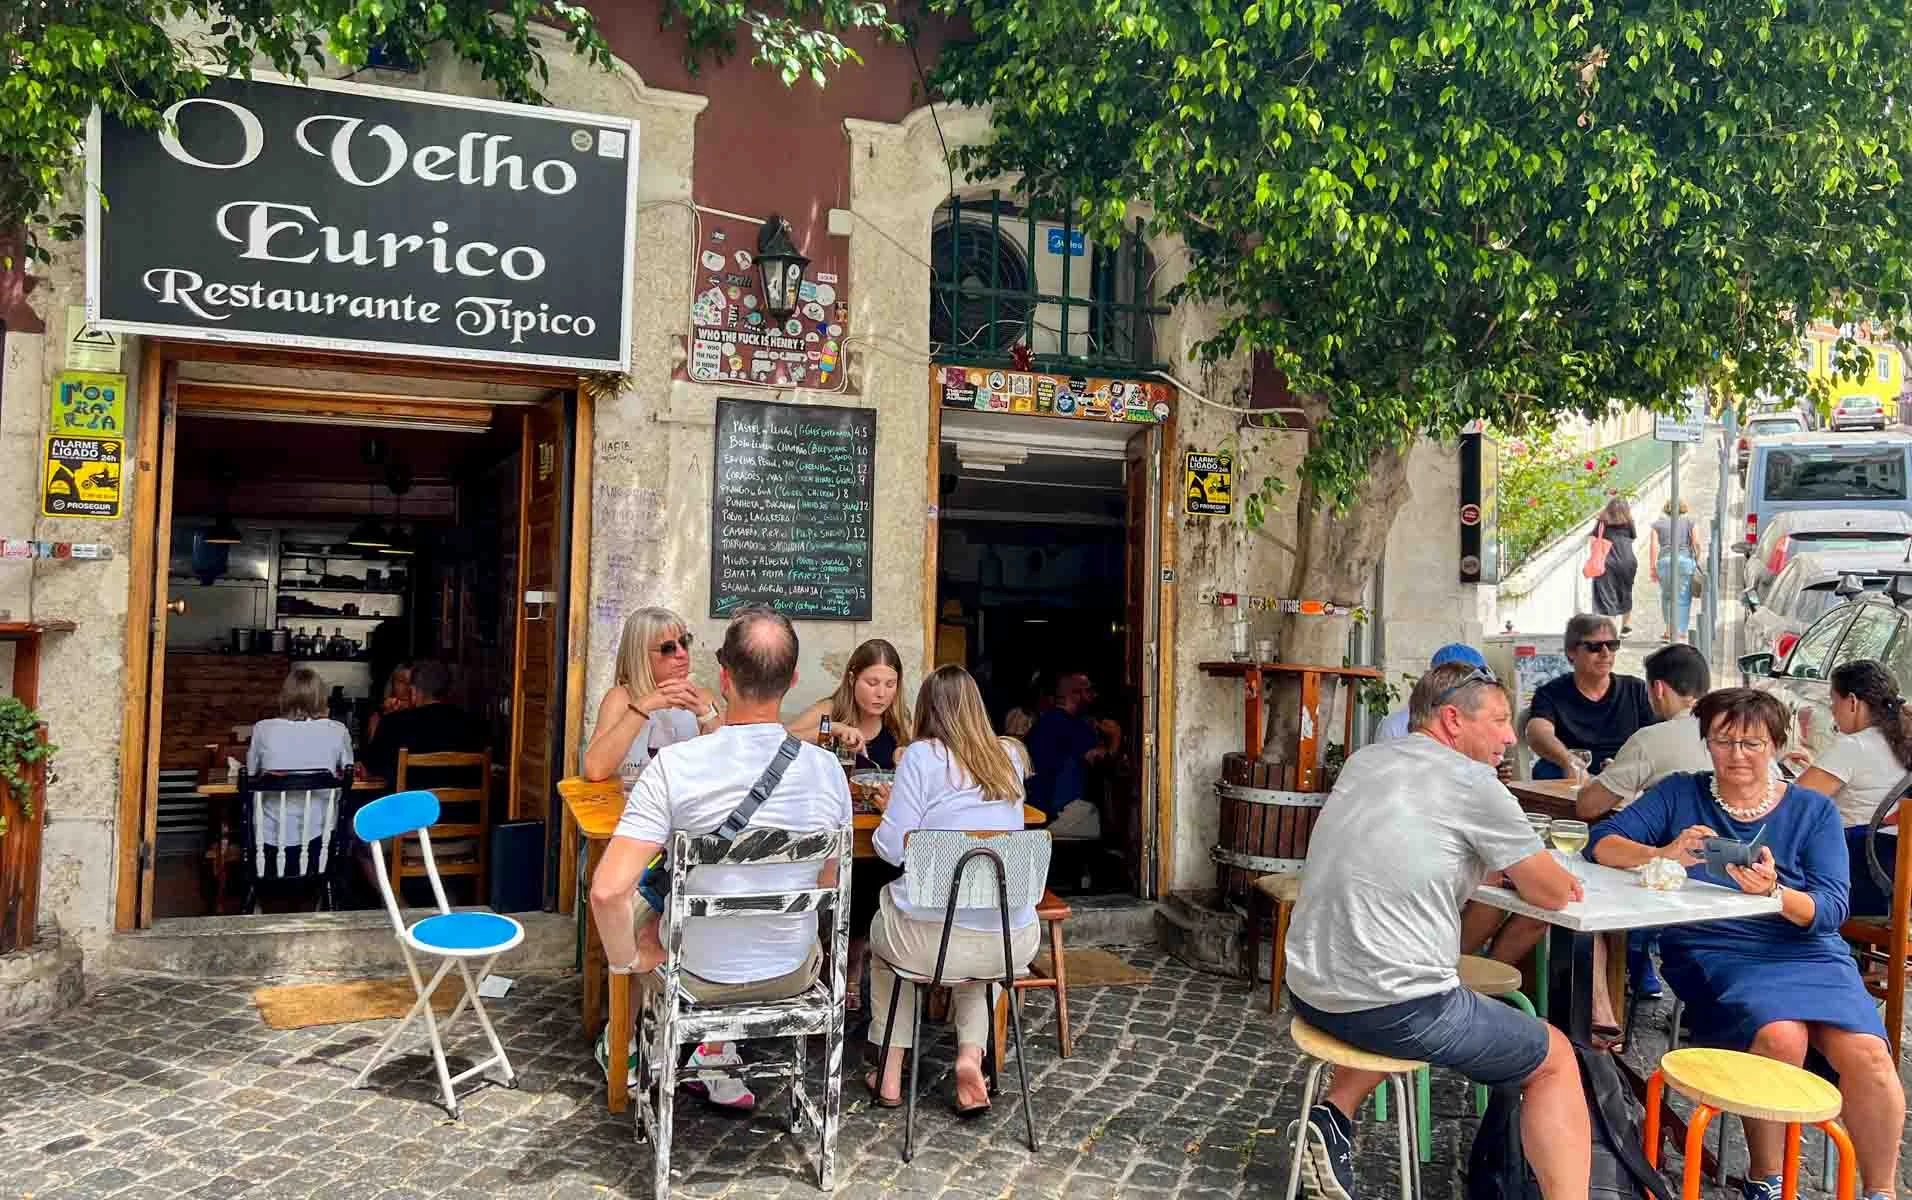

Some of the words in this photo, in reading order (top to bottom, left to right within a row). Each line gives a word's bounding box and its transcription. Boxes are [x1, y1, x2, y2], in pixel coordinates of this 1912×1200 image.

[159, 98, 264, 169] O
[296, 114, 577, 195] Velho
[216, 200, 546, 281] Eurico
[143, 268, 441, 323] Restaurante
[698, 328, 720, 341] WHO
[721, 331, 737, 343] THE
[738, 332, 760, 345] FUCK
[53, 440, 98, 449] ALARME
[52, 447, 98, 457] LIGADO
[1190, 462, 1218, 470] LIGADO
[67, 502, 111, 510] PROSEGUR
[853, 527, 865, 538] 12
